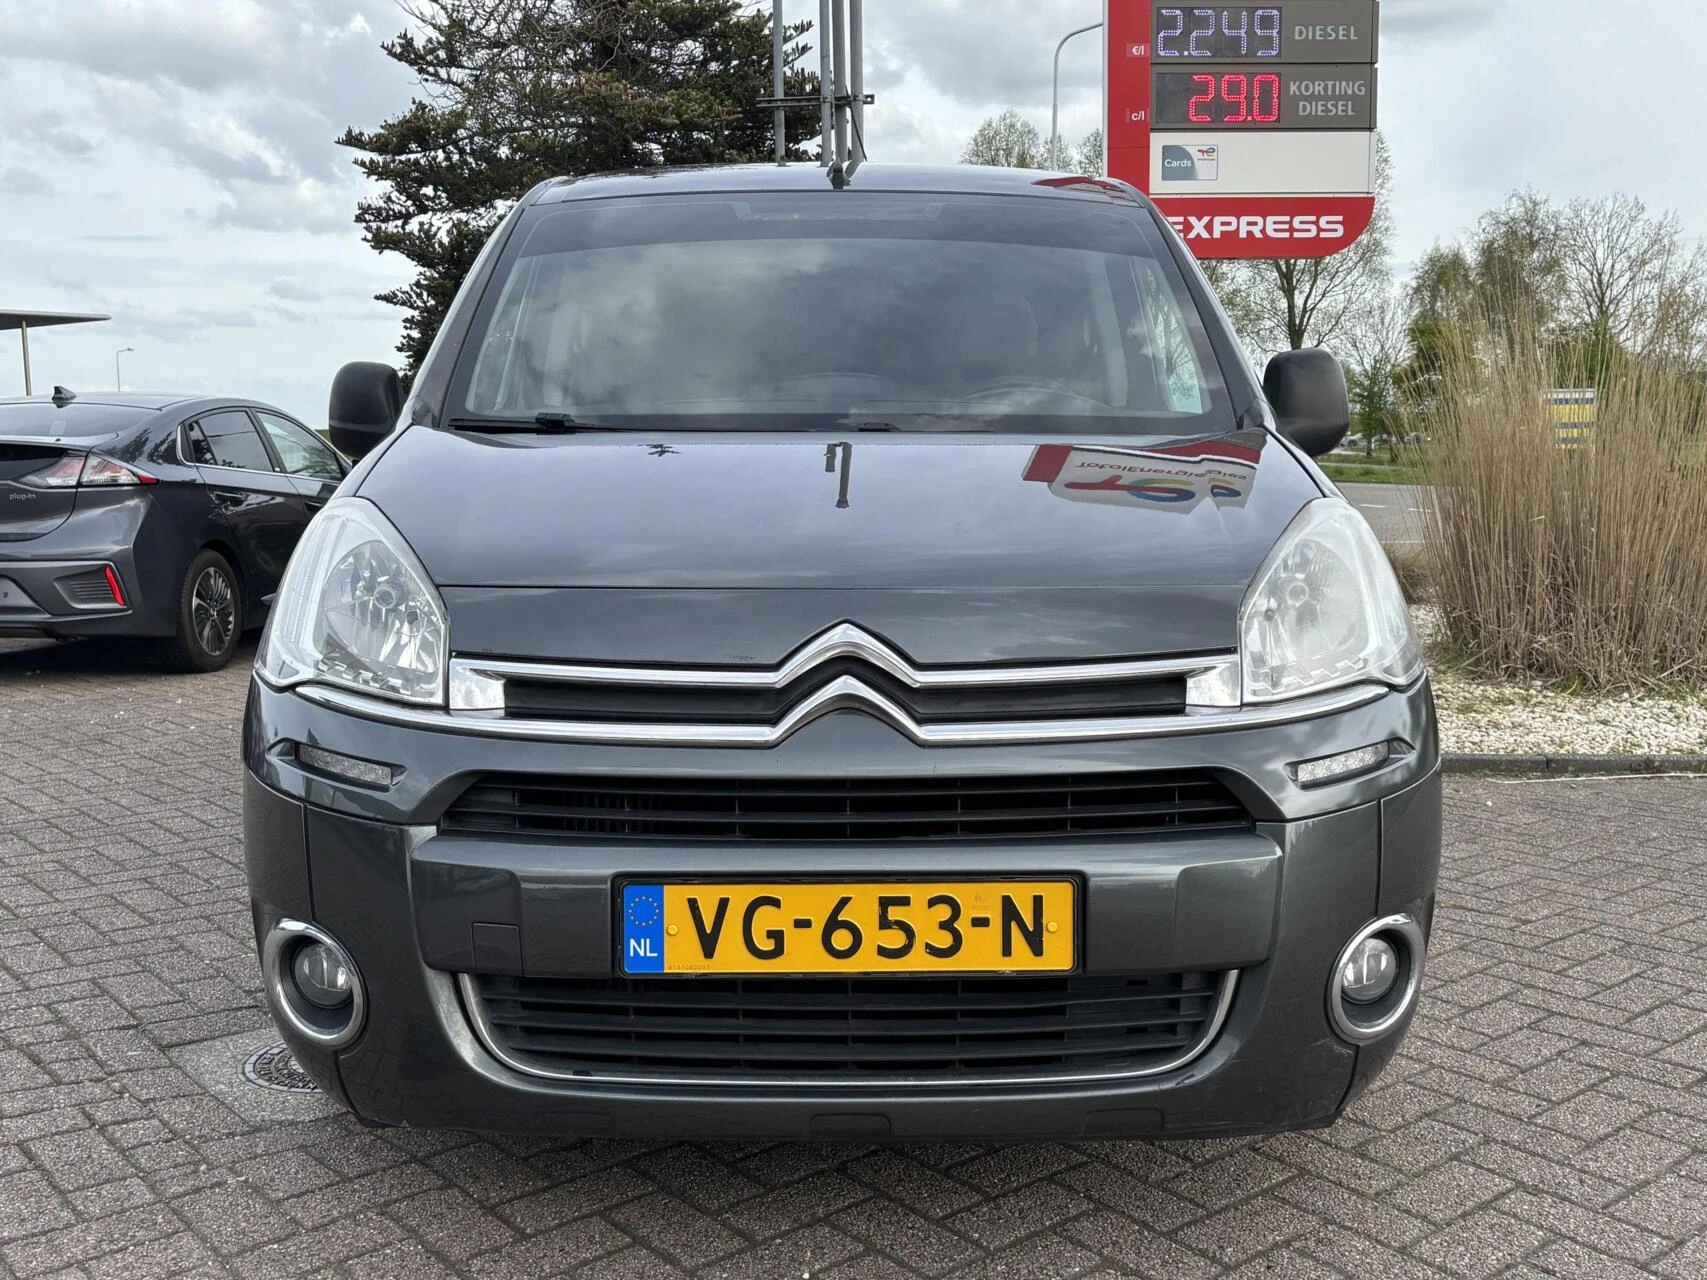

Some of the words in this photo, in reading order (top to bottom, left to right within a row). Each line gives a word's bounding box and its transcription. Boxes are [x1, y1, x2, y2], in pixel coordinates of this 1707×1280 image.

[1157, 9, 1280, 56] 2.249
[1294, 25, 1359, 40] DIESEL
[1289, 80, 1366, 95] KORTING
[1188, 74, 1279, 122] 29.0
[1298, 101, 1356, 115] DIESEL
[1164, 158, 1192, 167] Cards
[687, 894, 1045, 960] VG-653-N
[629, 937, 659, 957] NL
